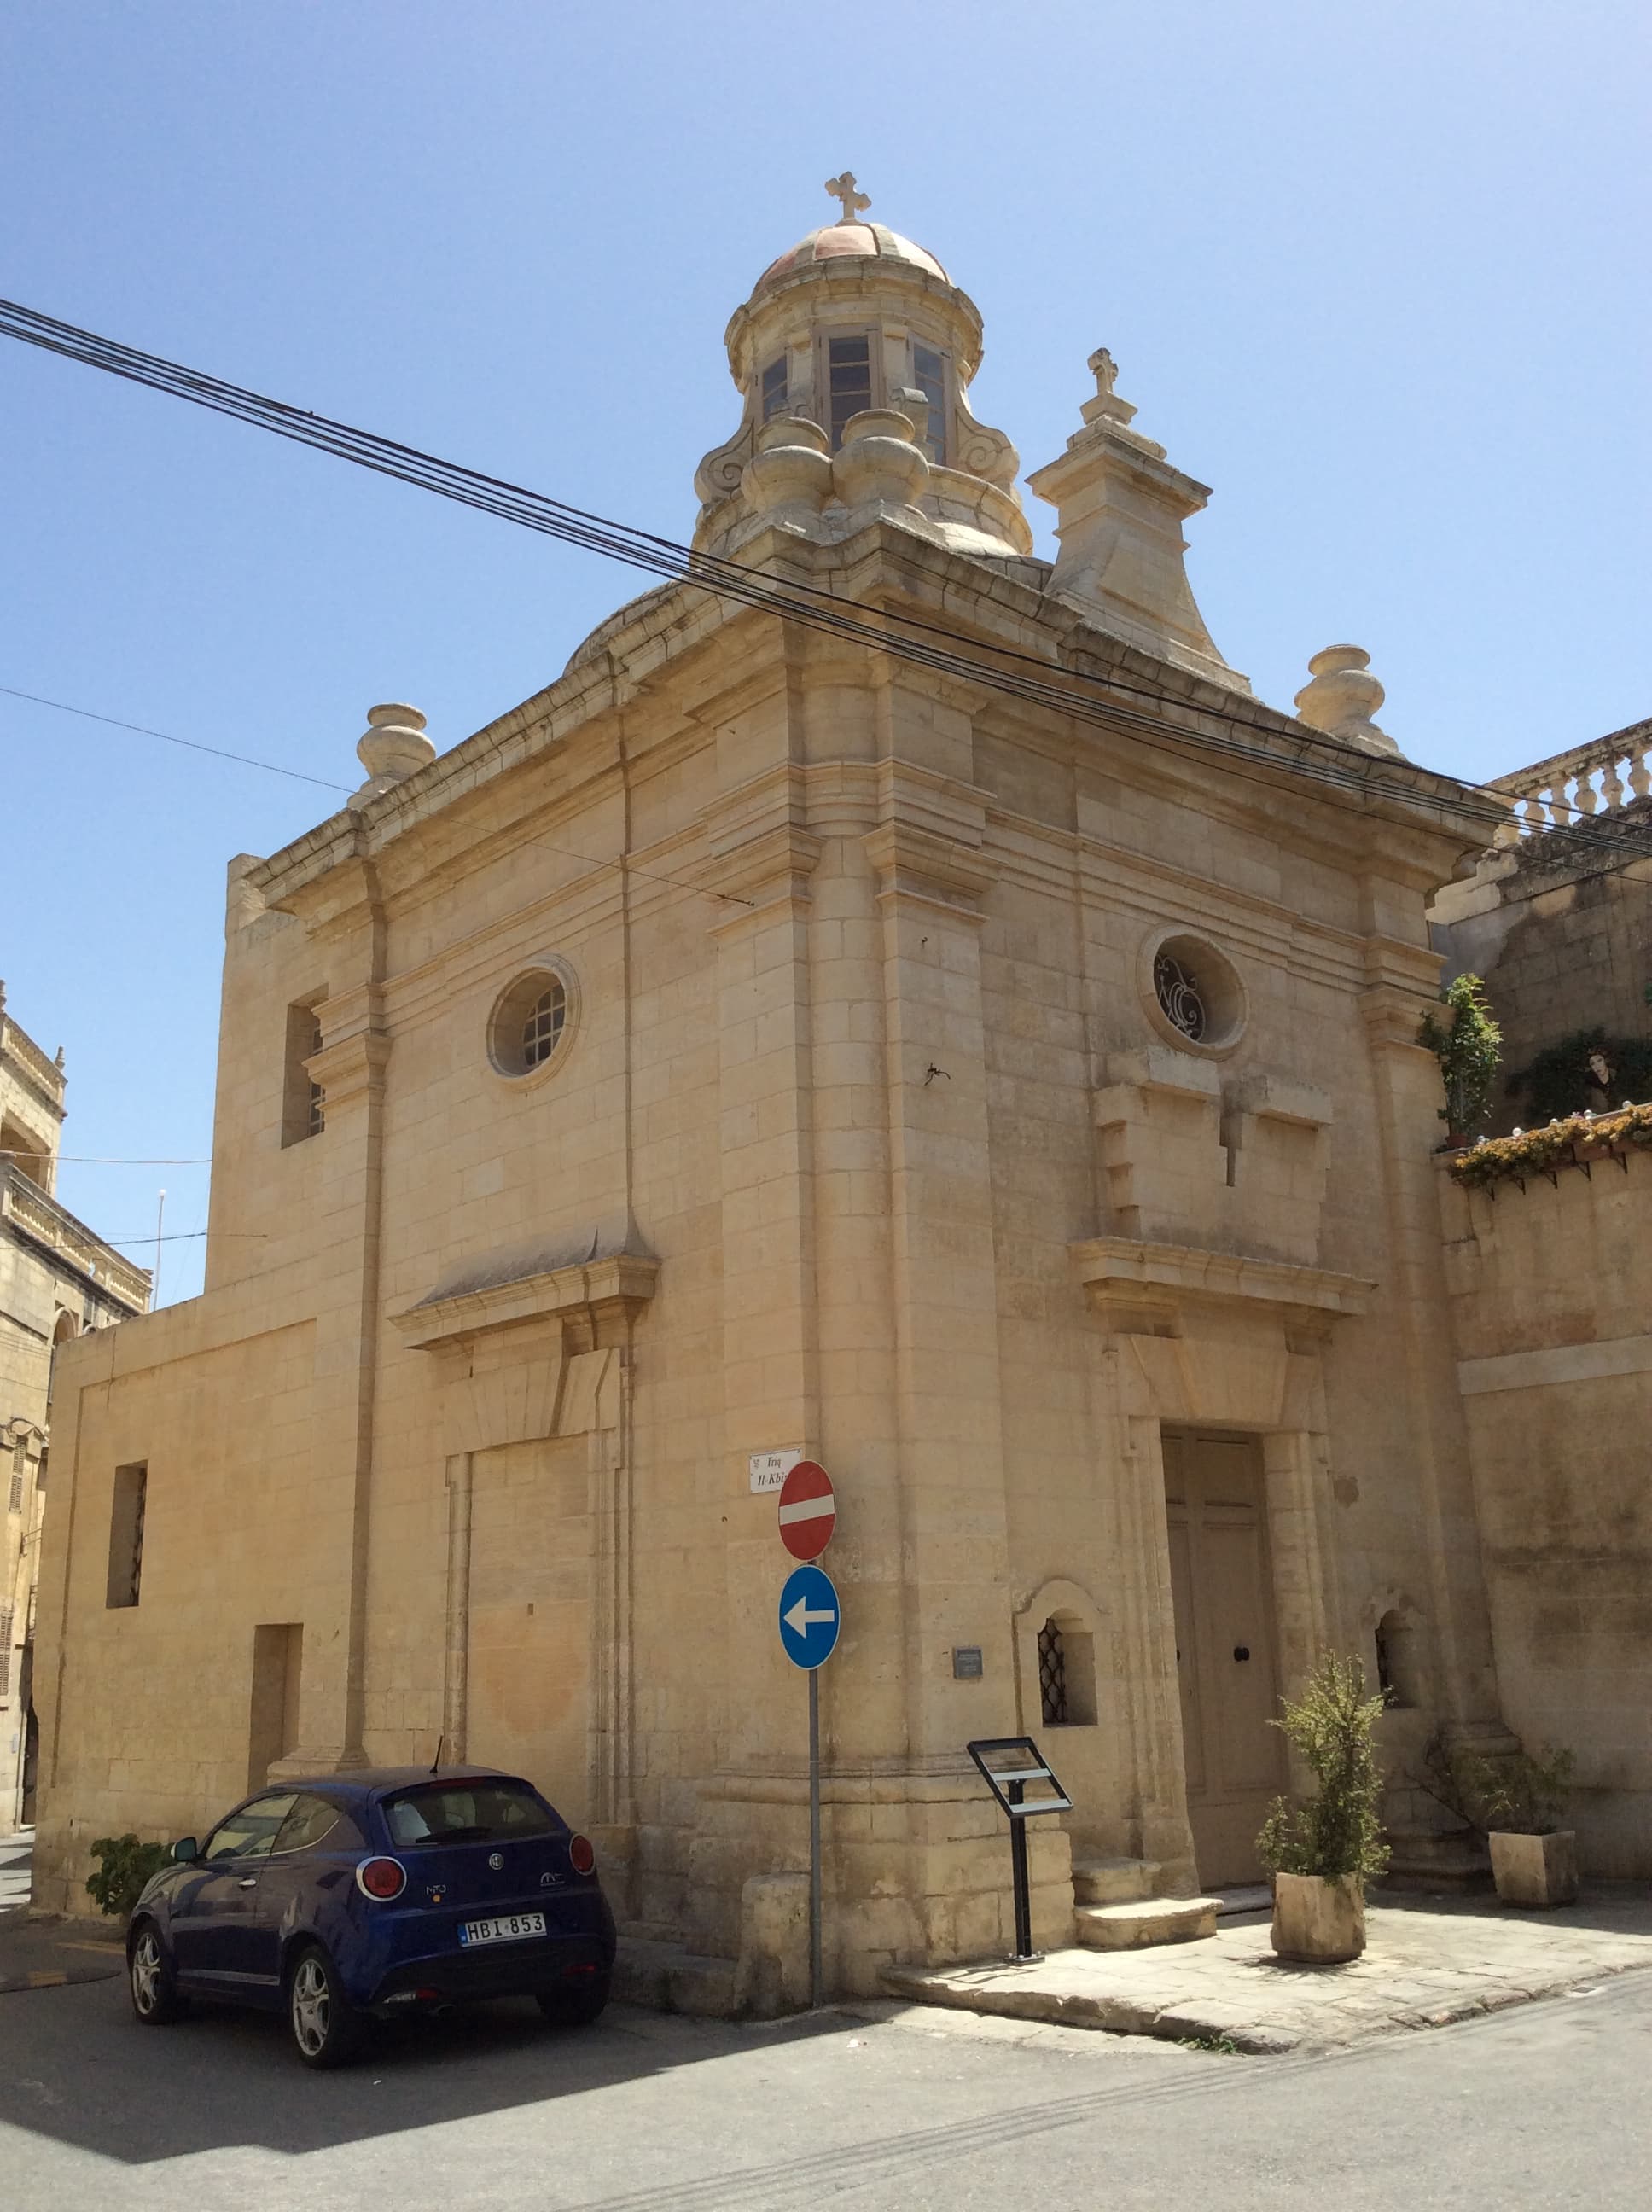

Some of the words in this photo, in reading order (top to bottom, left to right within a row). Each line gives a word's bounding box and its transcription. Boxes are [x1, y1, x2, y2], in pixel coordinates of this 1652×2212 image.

[768, 1457, 781, 1468] Triq
[468, 1920, 503, 1941] HBI
[510, 1915, 543, 1935] 853
